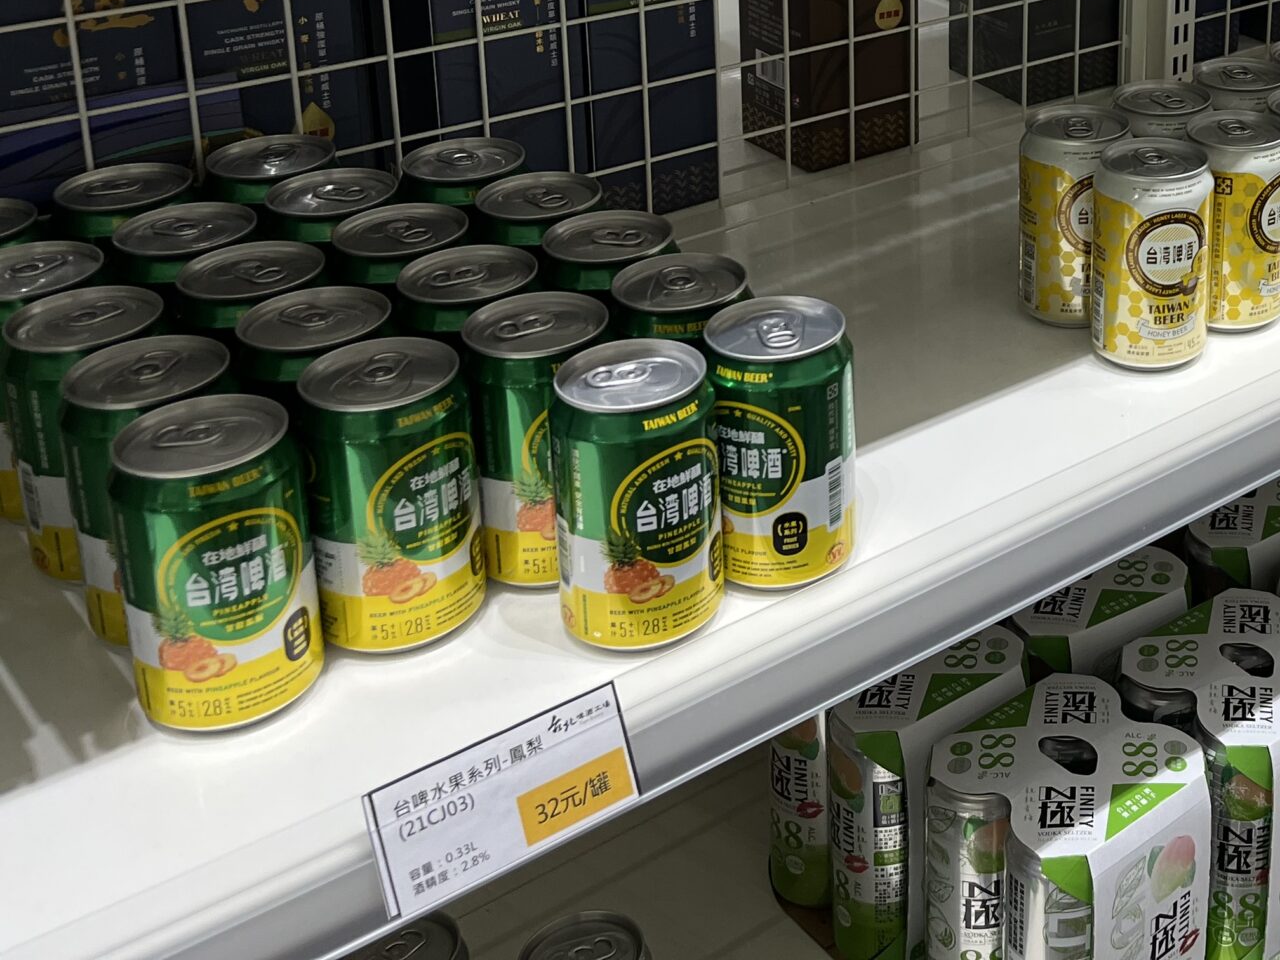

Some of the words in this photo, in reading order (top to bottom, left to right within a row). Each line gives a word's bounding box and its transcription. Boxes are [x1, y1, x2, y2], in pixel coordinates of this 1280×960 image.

[482, 9, 520, 24] WHEAT
[241, 64, 270, 75] VIRGIN
[271, 61, 288, 71] OAK
[1148, 300, 1189, 315] TAIWAN
[1154, 313, 1184, 326] BEER
[1147, 328, 1170, 338] HONEY
[1172, 326, 1188, 337] BEER
[716, 365, 742, 382] TAIWAN
[744, 372, 767, 385] BEER
[397, 409, 433, 428] TAIWAN
[642, 412, 677, 431] TAIWAN
[678, 401, 697, 420] BEER
[746, 413, 775, 433] QUALITY
[774, 428, 788, 444] AND
[652, 463, 702, 494] 在地鮮釀
[621, 481, 637, 515] NATURAL
[418, 513, 461, 538] PINEAPPLE
[658, 519, 702, 541] PINEAPPLE
[213, 594, 269, 617] PINEAPPLE
[408, 596, 445, 613] PINEAPPLE
[628, 607, 645, 616] WITH
[647, 597, 682, 613] PINEAPPLE
[1067, 588, 1086, 619] FINITY
[1223, 605, 1236, 633] FINITY
[894, 674, 915, 709] FINITY
[1260, 687, 1273, 724] FINITY
[1044, 691, 1060, 724] FINITY
[393, 735, 543, 818] 台啤水果系列-鳳梨
[793, 758, 808, 810] FINITY
[535, 771, 611, 824] 32元/罐
[1079, 786, 1095, 828] FINITY
[399, 792, 475, 842] (21CJ03)
[839, 808, 854, 854] FINITY
[1178, 890, 1191, 943] FINITY
